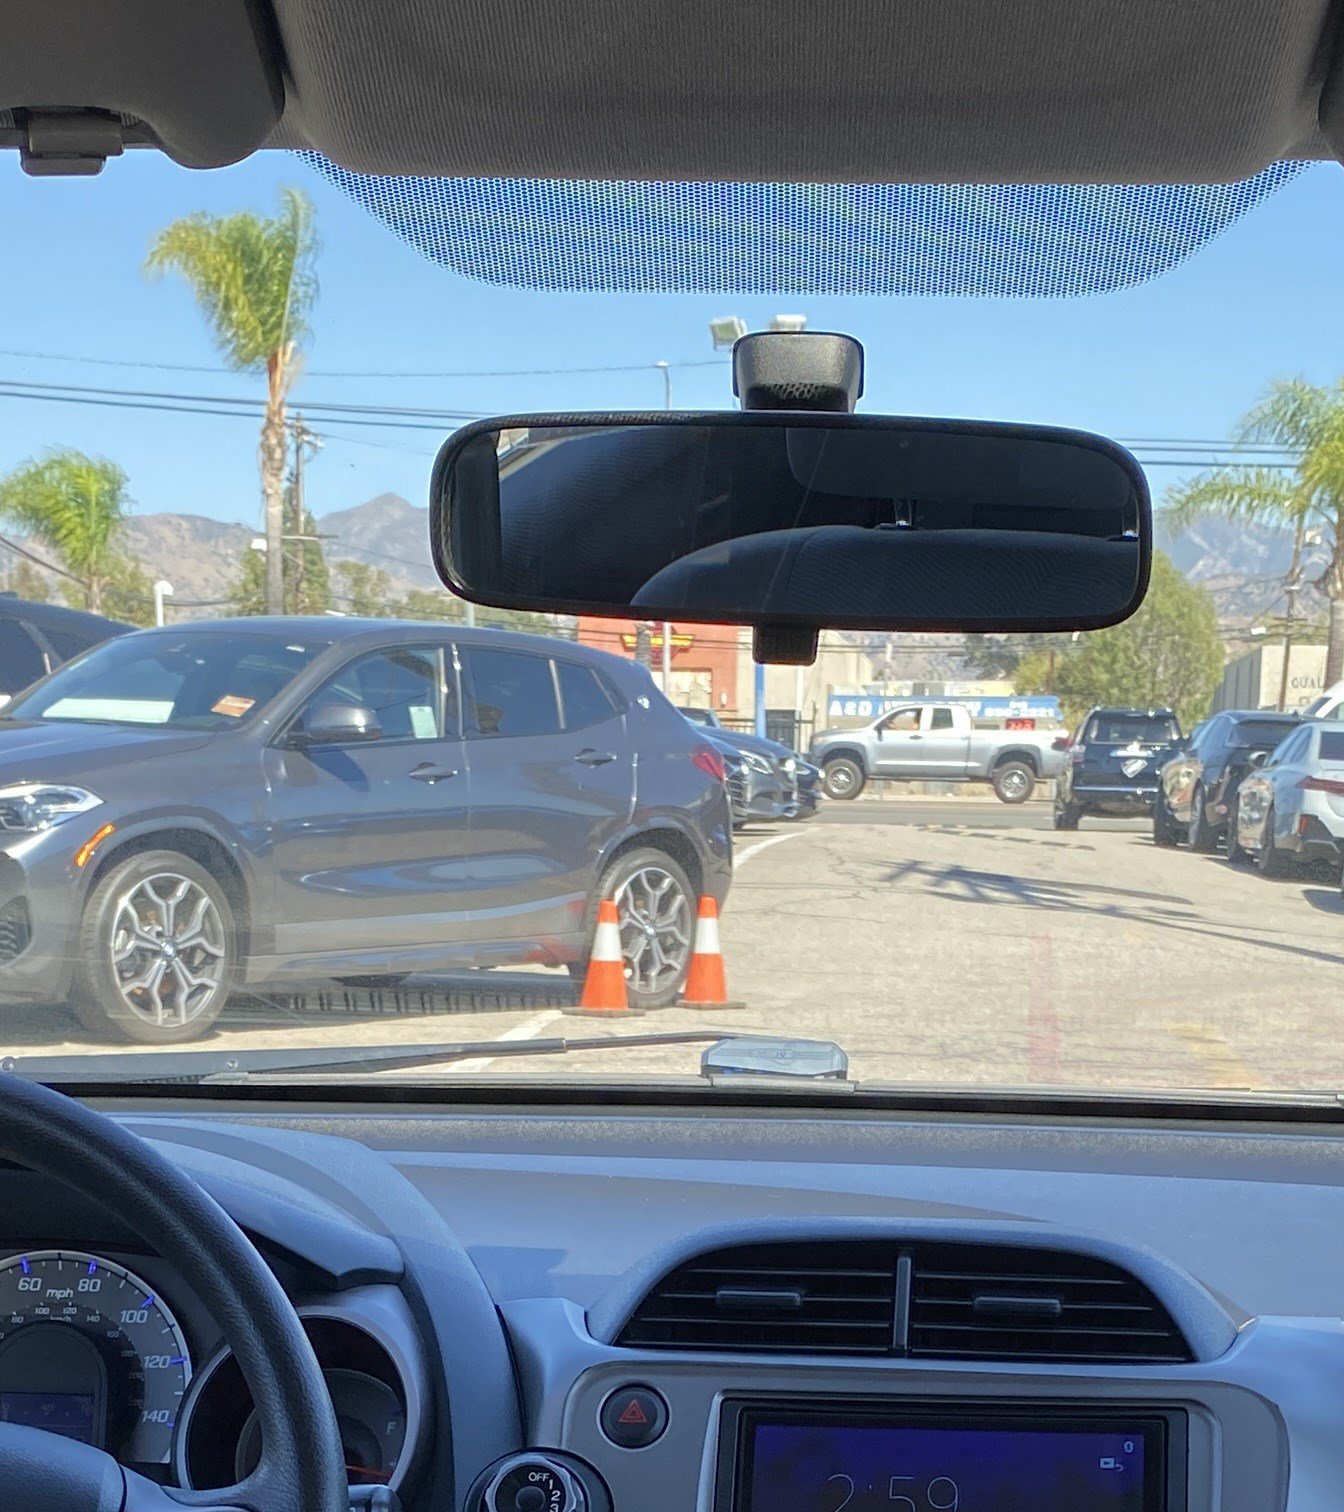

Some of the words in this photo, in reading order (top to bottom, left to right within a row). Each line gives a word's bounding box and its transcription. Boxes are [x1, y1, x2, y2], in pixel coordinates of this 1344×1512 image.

[18, 1277, 42, 1291] 60
[78, 1278, 101, 1292] 80
[46, 1287, 73, 1299] mph
[120, 1310, 148, 1323] 100
[144, 1355, 170, 1368] 120
[142, 1409, 169, 1423] 140
[387, 1421, 397, 1435] F
[528, 1471, 550, 1482] OFF
[549, 1479, 554, 1490] 1
[551, 1490, 561, 1501] 2
